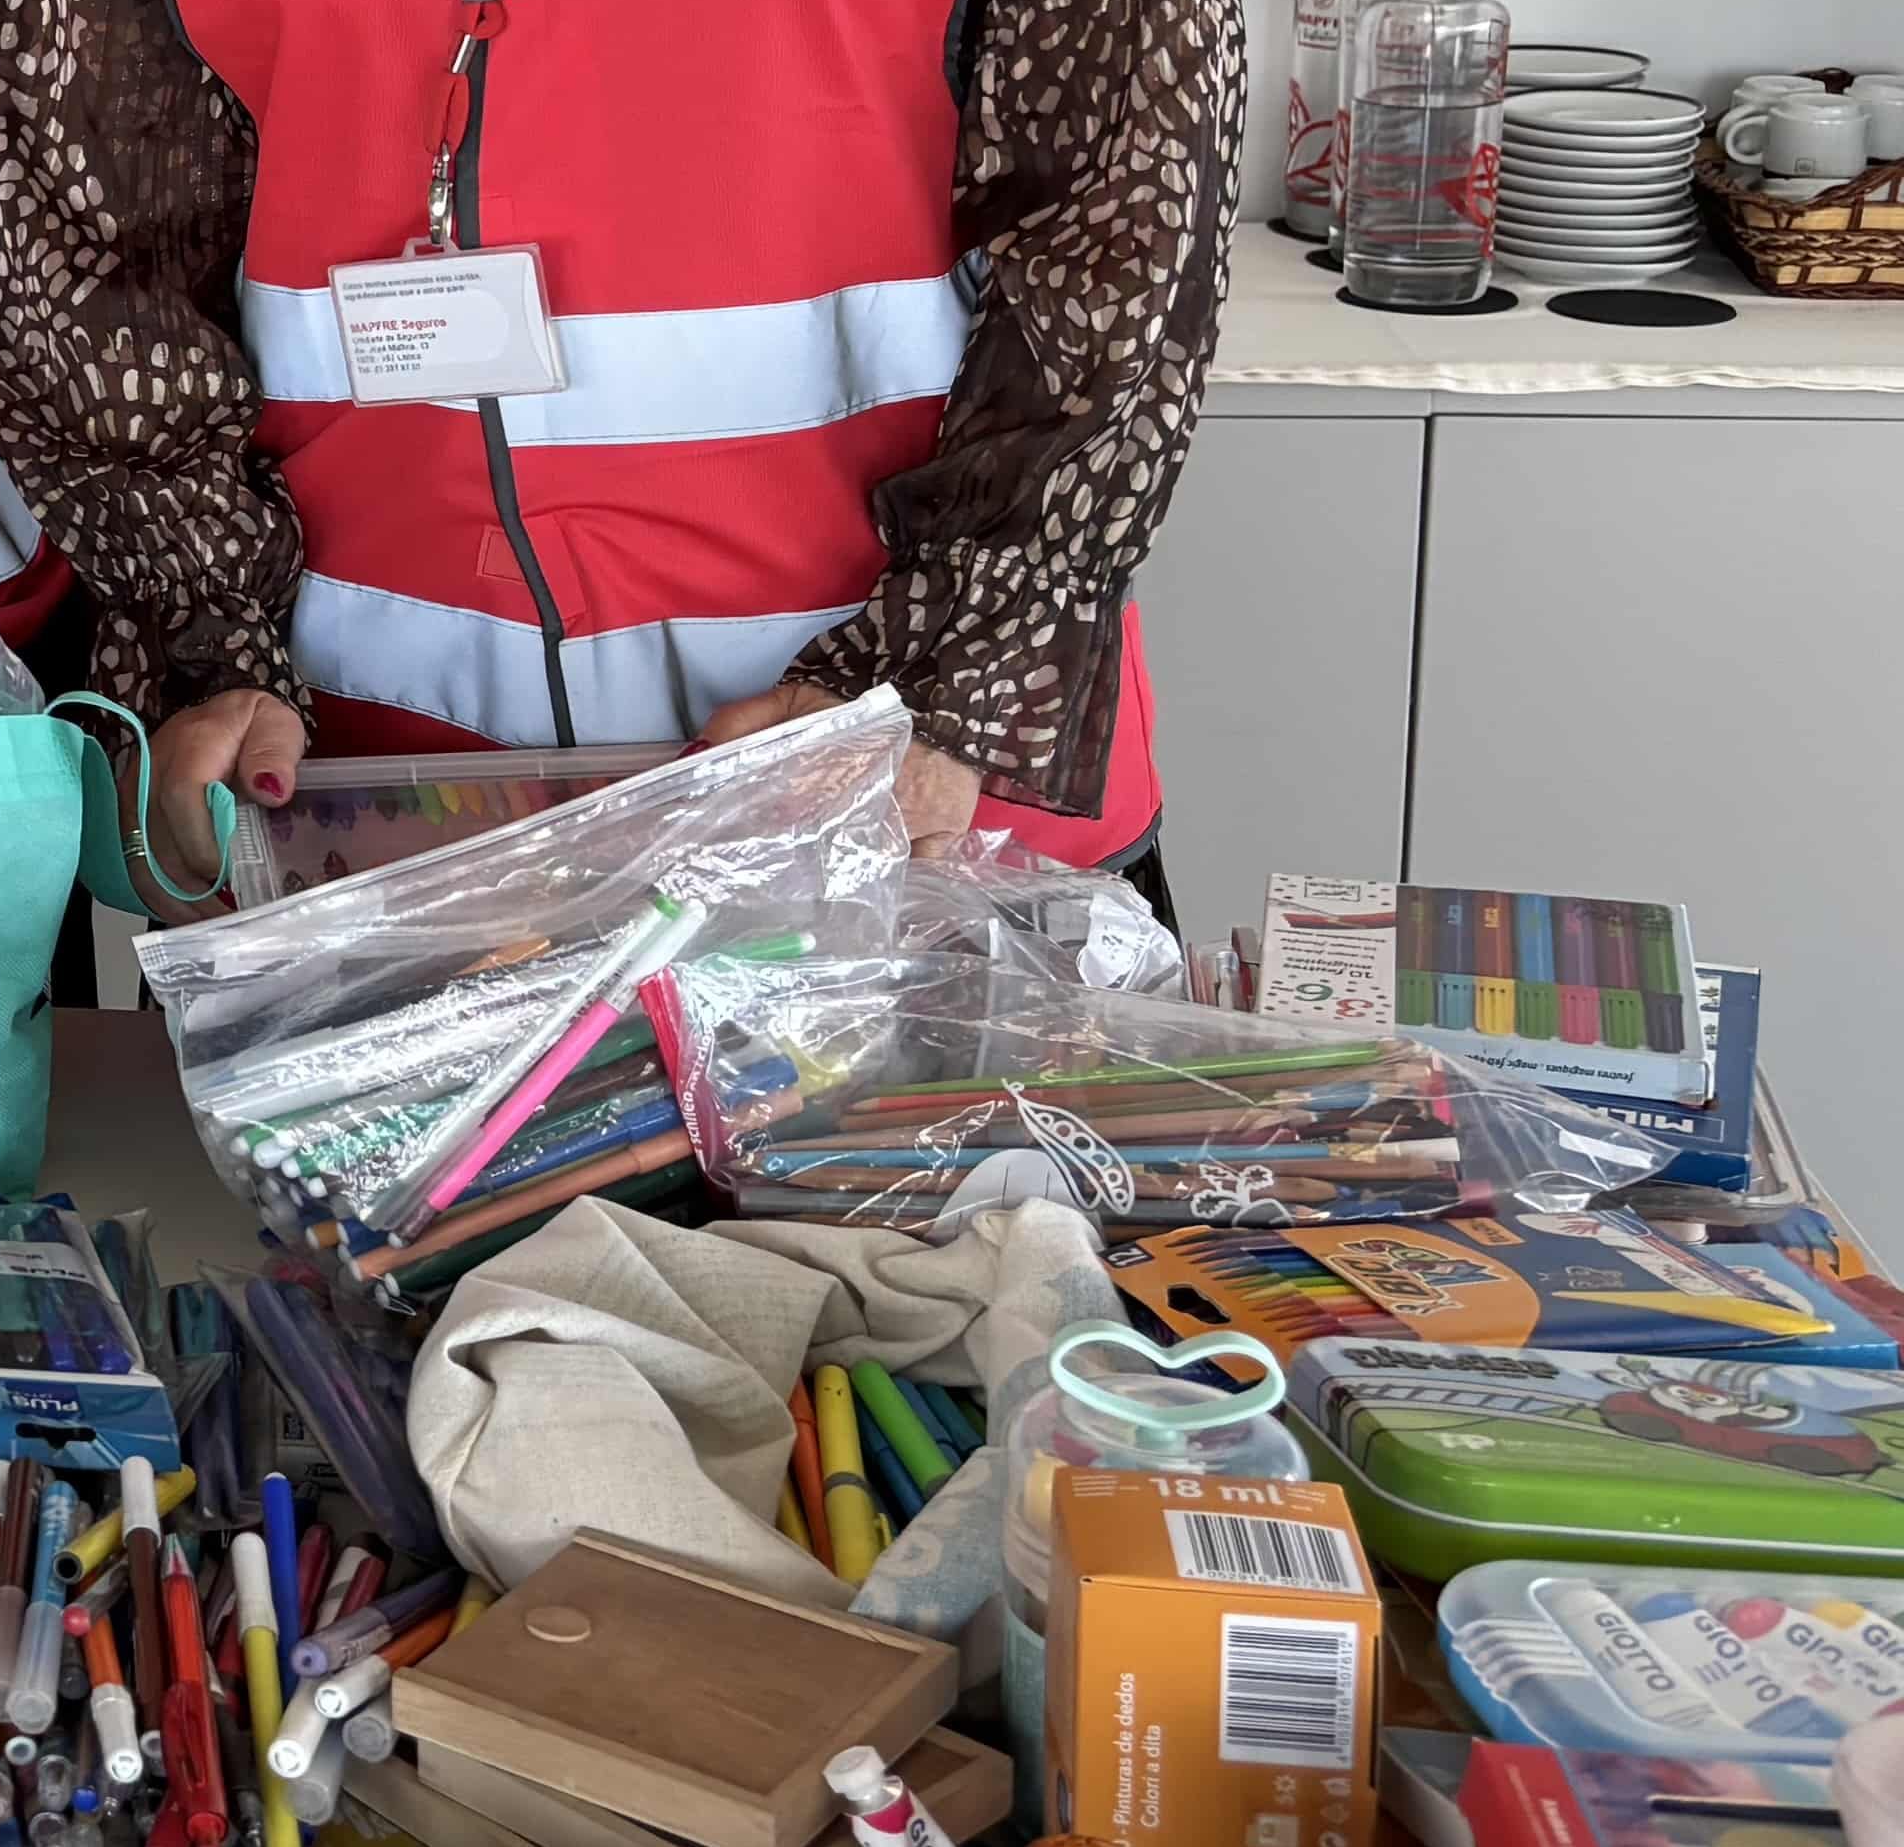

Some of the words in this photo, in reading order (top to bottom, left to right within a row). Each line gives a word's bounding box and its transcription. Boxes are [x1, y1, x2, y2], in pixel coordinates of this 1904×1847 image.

[350, 319, 397, 334] MAPFRE
[401, 318, 447, 334] Seguros
[1598, 1068, 1635, 1083] feutres
[1594, 1106, 1696, 1135] MIL
[6, 1263, 88, 1281] PLUS
[1352, 1255, 1433, 1300] BIC
[10, 1393, 81, 1414] PLUS
[1147, 1477, 1204, 1498] 18
[1219, 1483, 1286, 1505] ml
[1593, 1610, 1677, 1694] GIOTTO
[1113, 1672, 1136, 1719] dedos
[1113, 1723, 1135, 1753] de
[1142, 1724, 1162, 1756] dita
[1146, 1755, 1161, 1769] a
[1112, 1752, 1135, 1825] Pinturas
[1140, 1772, 1161, 1829] Colori
